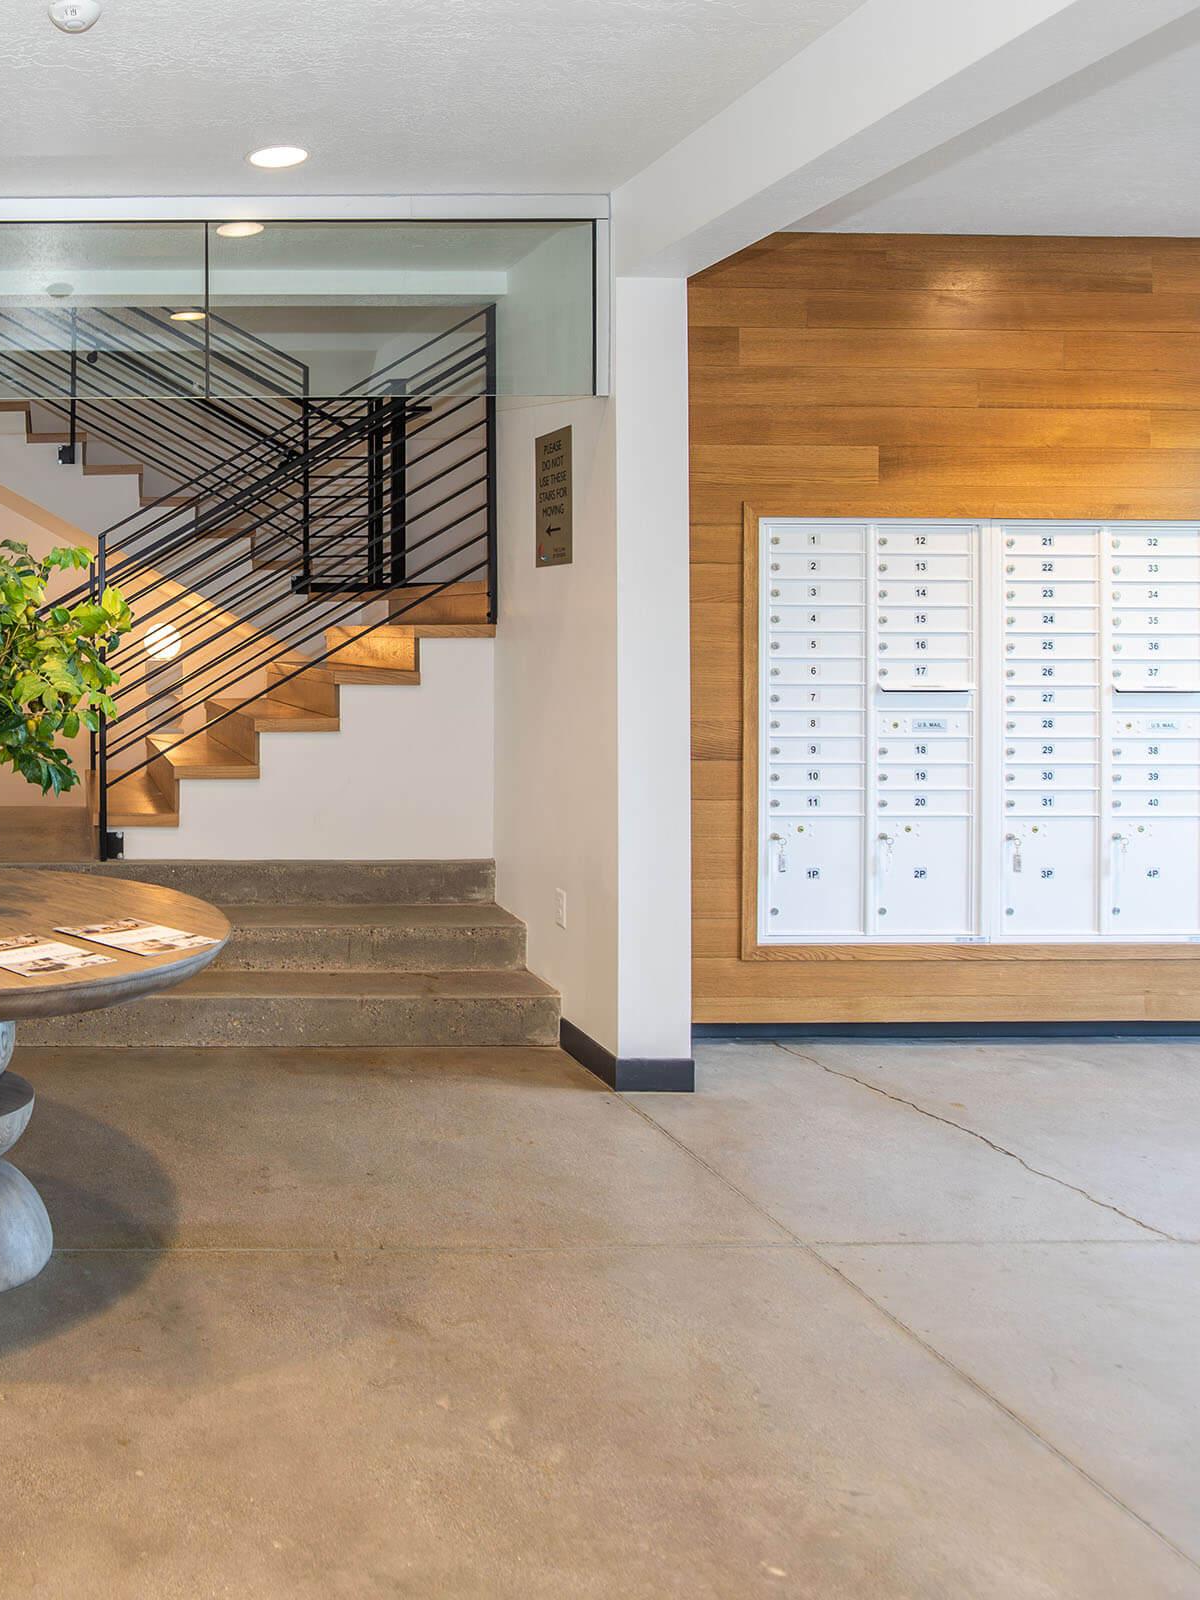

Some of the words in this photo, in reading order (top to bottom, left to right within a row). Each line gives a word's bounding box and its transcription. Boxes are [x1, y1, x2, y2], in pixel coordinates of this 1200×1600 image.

[544, 440, 562, 455] PLEASE
[542, 459, 551, 471] DO
[551, 455, 564, 469] NOT
[539, 475, 550, 488] USE
[550, 470, 567, 485] THESE
[539, 489, 556, 503] STAIRS
[556, 486, 568, 499] FOR
[542, 503, 564, 518] MOVING
[915, 536, 926, 545] 12
[1041, 537, 1052, 546] 21
[1147, 538, 1158, 547] 32
[915, 562, 927, 571] 13
[1042, 563, 1053, 572] 22
[1148, 564, 1159, 573] 33
[916, 589, 927, 597] 14
[1042, 589, 1054, 598] 23
[1148, 590, 1159, 599] 34
[915, 614, 927, 623] 15
[1042, 615, 1054, 624] 24
[1148, 616, 1159, 625] 35
[915, 640, 927, 649] 16
[1042, 641, 1054, 650] 25
[1148, 642, 1160, 651] 36
[916, 666, 927, 675] 17
[1042, 667, 1054, 676] 26
[1148, 668, 1159, 677] 37
[1042, 694, 1053, 703] 27
[1042, 719, 1054, 728] 28
[915, 745, 927, 754] 18
[1042, 745, 1054, 754] 29
[1148, 746, 1159, 755] 38
[807, 771, 819, 780] 10
[915, 771, 926, 780] 19
[1042, 771, 1054, 780] 30
[1148, 772, 1159, 781] 39
[808, 798, 818, 807] 11
[914, 798, 926, 807] 20
[1042, 798, 1052, 807] 31
[1147, 798, 1159, 807] 40
[807, 870, 819, 879] 1P
[913, 870, 927, 879] 2P
[1041, 870, 1053, 879] 3P
[1146, 869, 1159, 878] 4P
